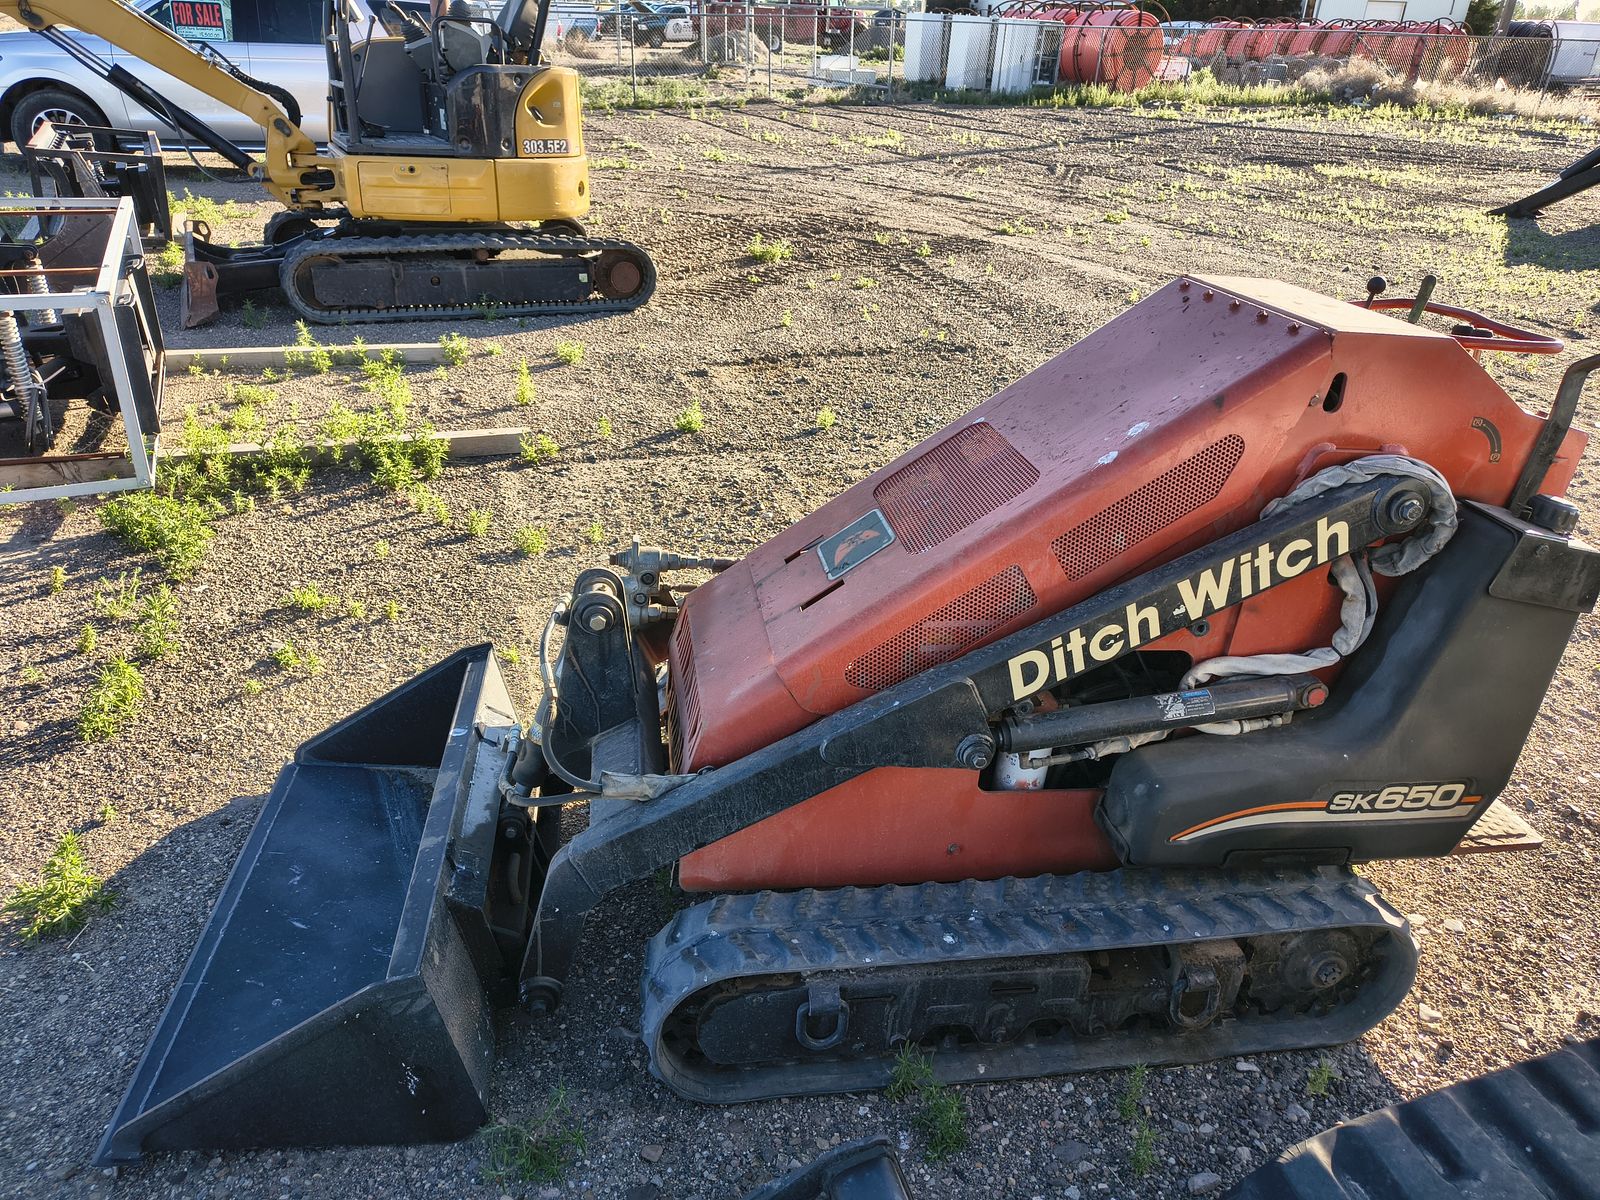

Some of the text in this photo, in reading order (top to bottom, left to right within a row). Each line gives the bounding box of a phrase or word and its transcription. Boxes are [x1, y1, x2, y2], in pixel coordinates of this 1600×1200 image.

[172, 2, 223, 27] FOR SALE
[523, 139, 567, 154] 303.5E2
[1008, 516, 1350, 701] Ditch Witch
[1329, 783, 1466, 811] SK650
